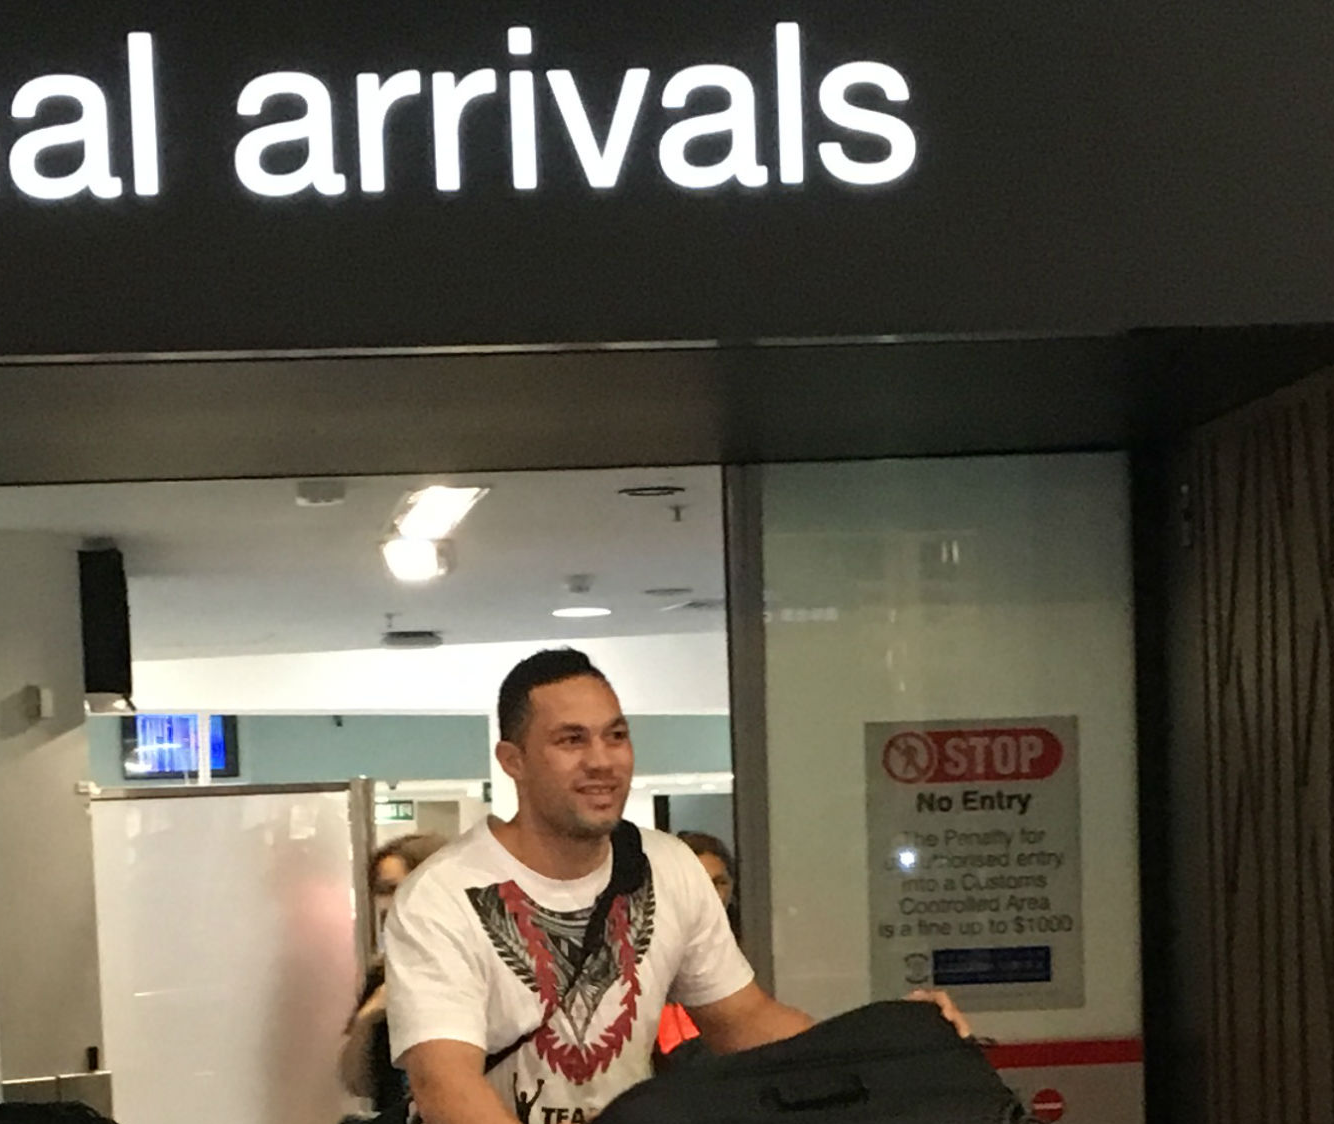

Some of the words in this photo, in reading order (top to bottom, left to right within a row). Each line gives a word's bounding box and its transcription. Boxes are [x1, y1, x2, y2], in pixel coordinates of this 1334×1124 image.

[233, 22, 918, 198] arrivals
[943, 735, 1044, 777] STOP
[917, 792, 953, 813] No
[962, 790, 1032, 815] Entry
[943, 829, 1013, 848] Penalty
[1020, 827, 1046, 845] for
[1017, 851, 1065, 869] entry
[902, 876, 939, 893] into
[943, 877, 957, 891] a
[961, 873, 1048, 892] Customs
[899, 896, 1000, 916] Controlled
[1006, 894, 1051, 912] Area
[900, 923, 912, 937] a
[918, 918, 952, 937] fine
[959, 920, 983, 938] up
[988, 918, 1008, 935] to
[1013, 914, 1074, 935] $1000
